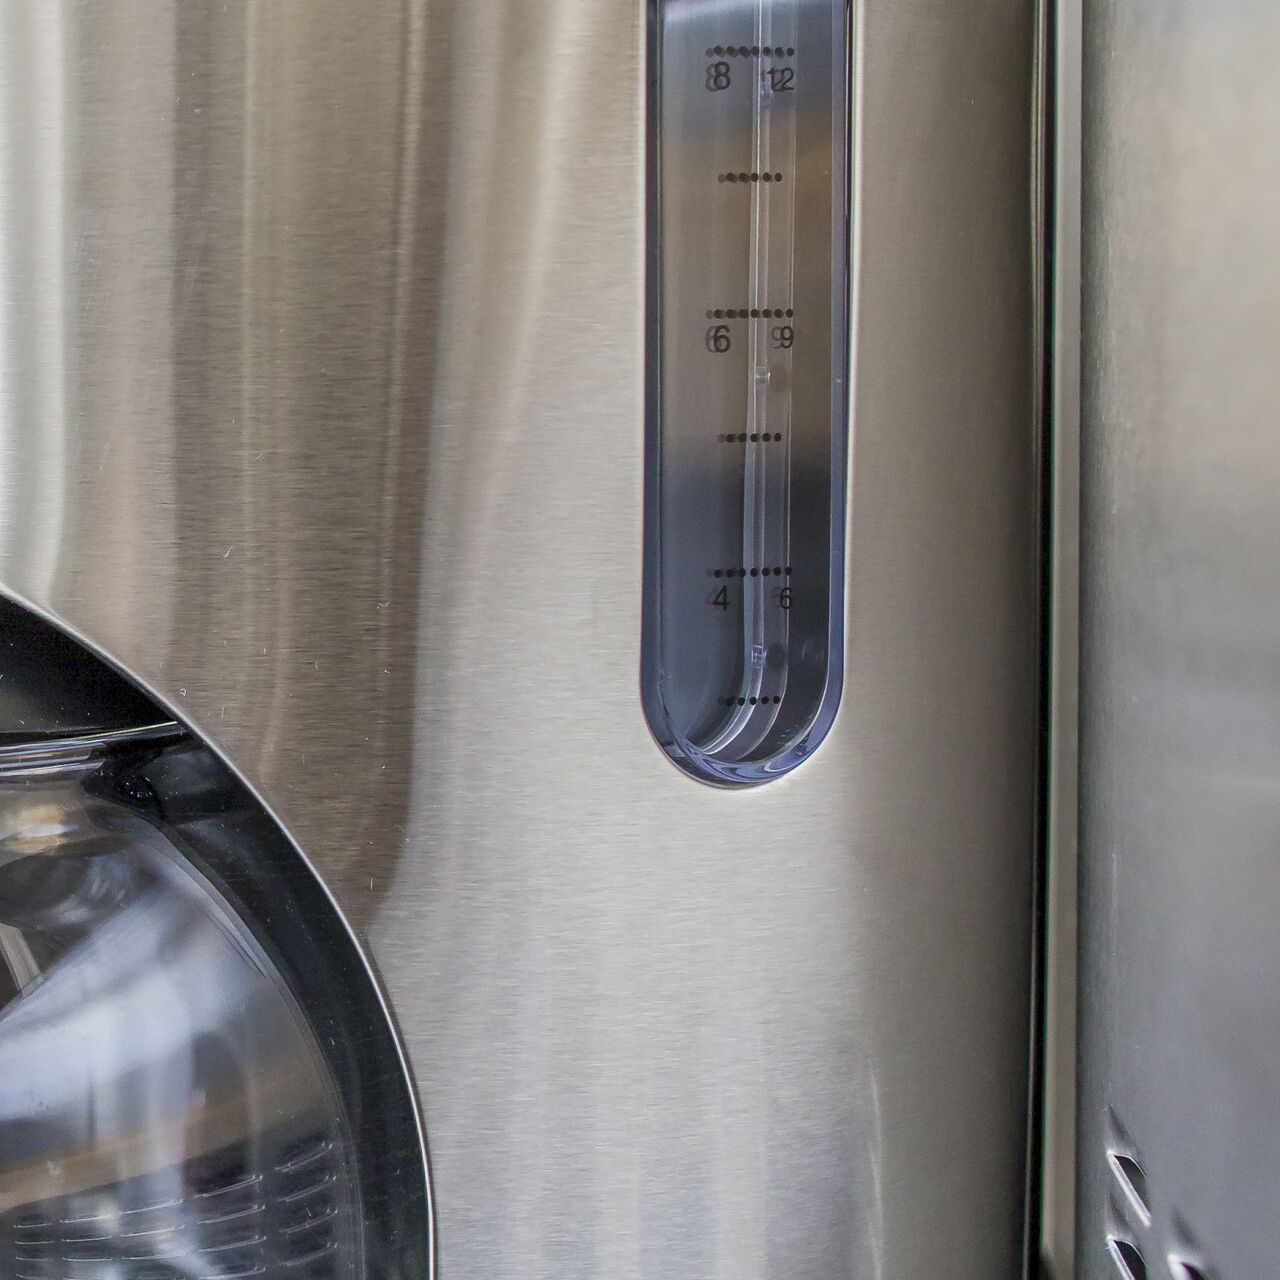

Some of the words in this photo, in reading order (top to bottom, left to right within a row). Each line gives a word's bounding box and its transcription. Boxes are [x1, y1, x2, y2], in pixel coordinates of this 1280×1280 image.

[713, 61, 731, 90] 8
[767, 67, 795, 91] 12
[713, 324, 731, 353] 6
[780, 325, 794, 349] 9
[713, 584, 731, 612] 4
[780, 587, 793, 609] 6
